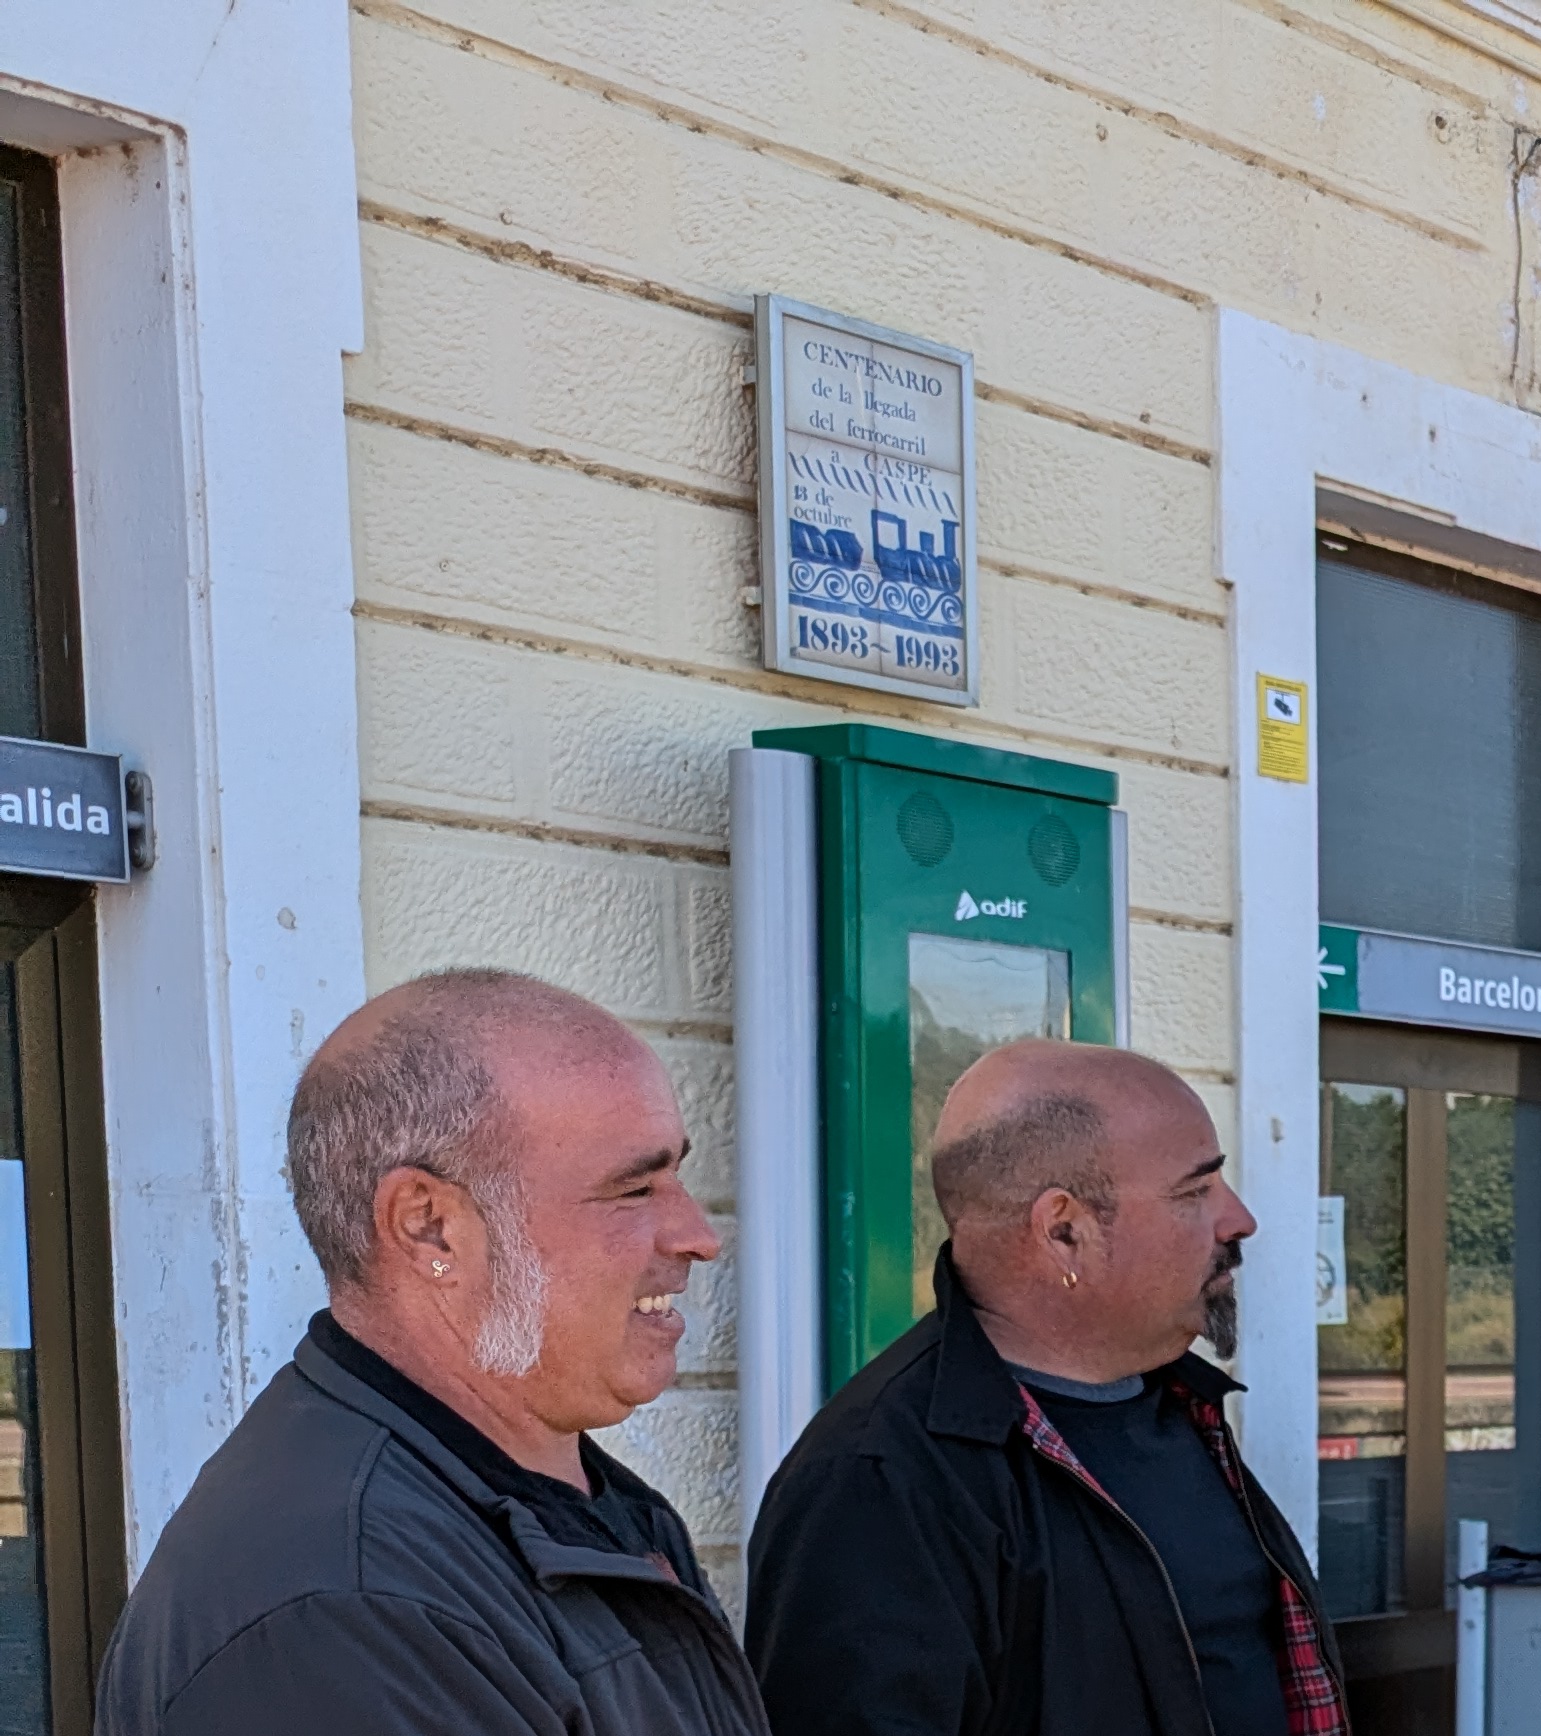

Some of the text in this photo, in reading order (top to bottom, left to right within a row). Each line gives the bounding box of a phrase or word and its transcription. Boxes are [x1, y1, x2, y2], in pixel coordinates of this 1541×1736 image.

[803, 340, 943, 397] CENTENARIO
[811, 377, 917, 422] de la llegada
[809, 409, 926, 456] del ferrocarril
[831, 450, 933, 487] a CASPE
[815, 487, 835, 507] de
[794, 506, 853, 529] octubre
[980, 896, 1028, 919] adif
